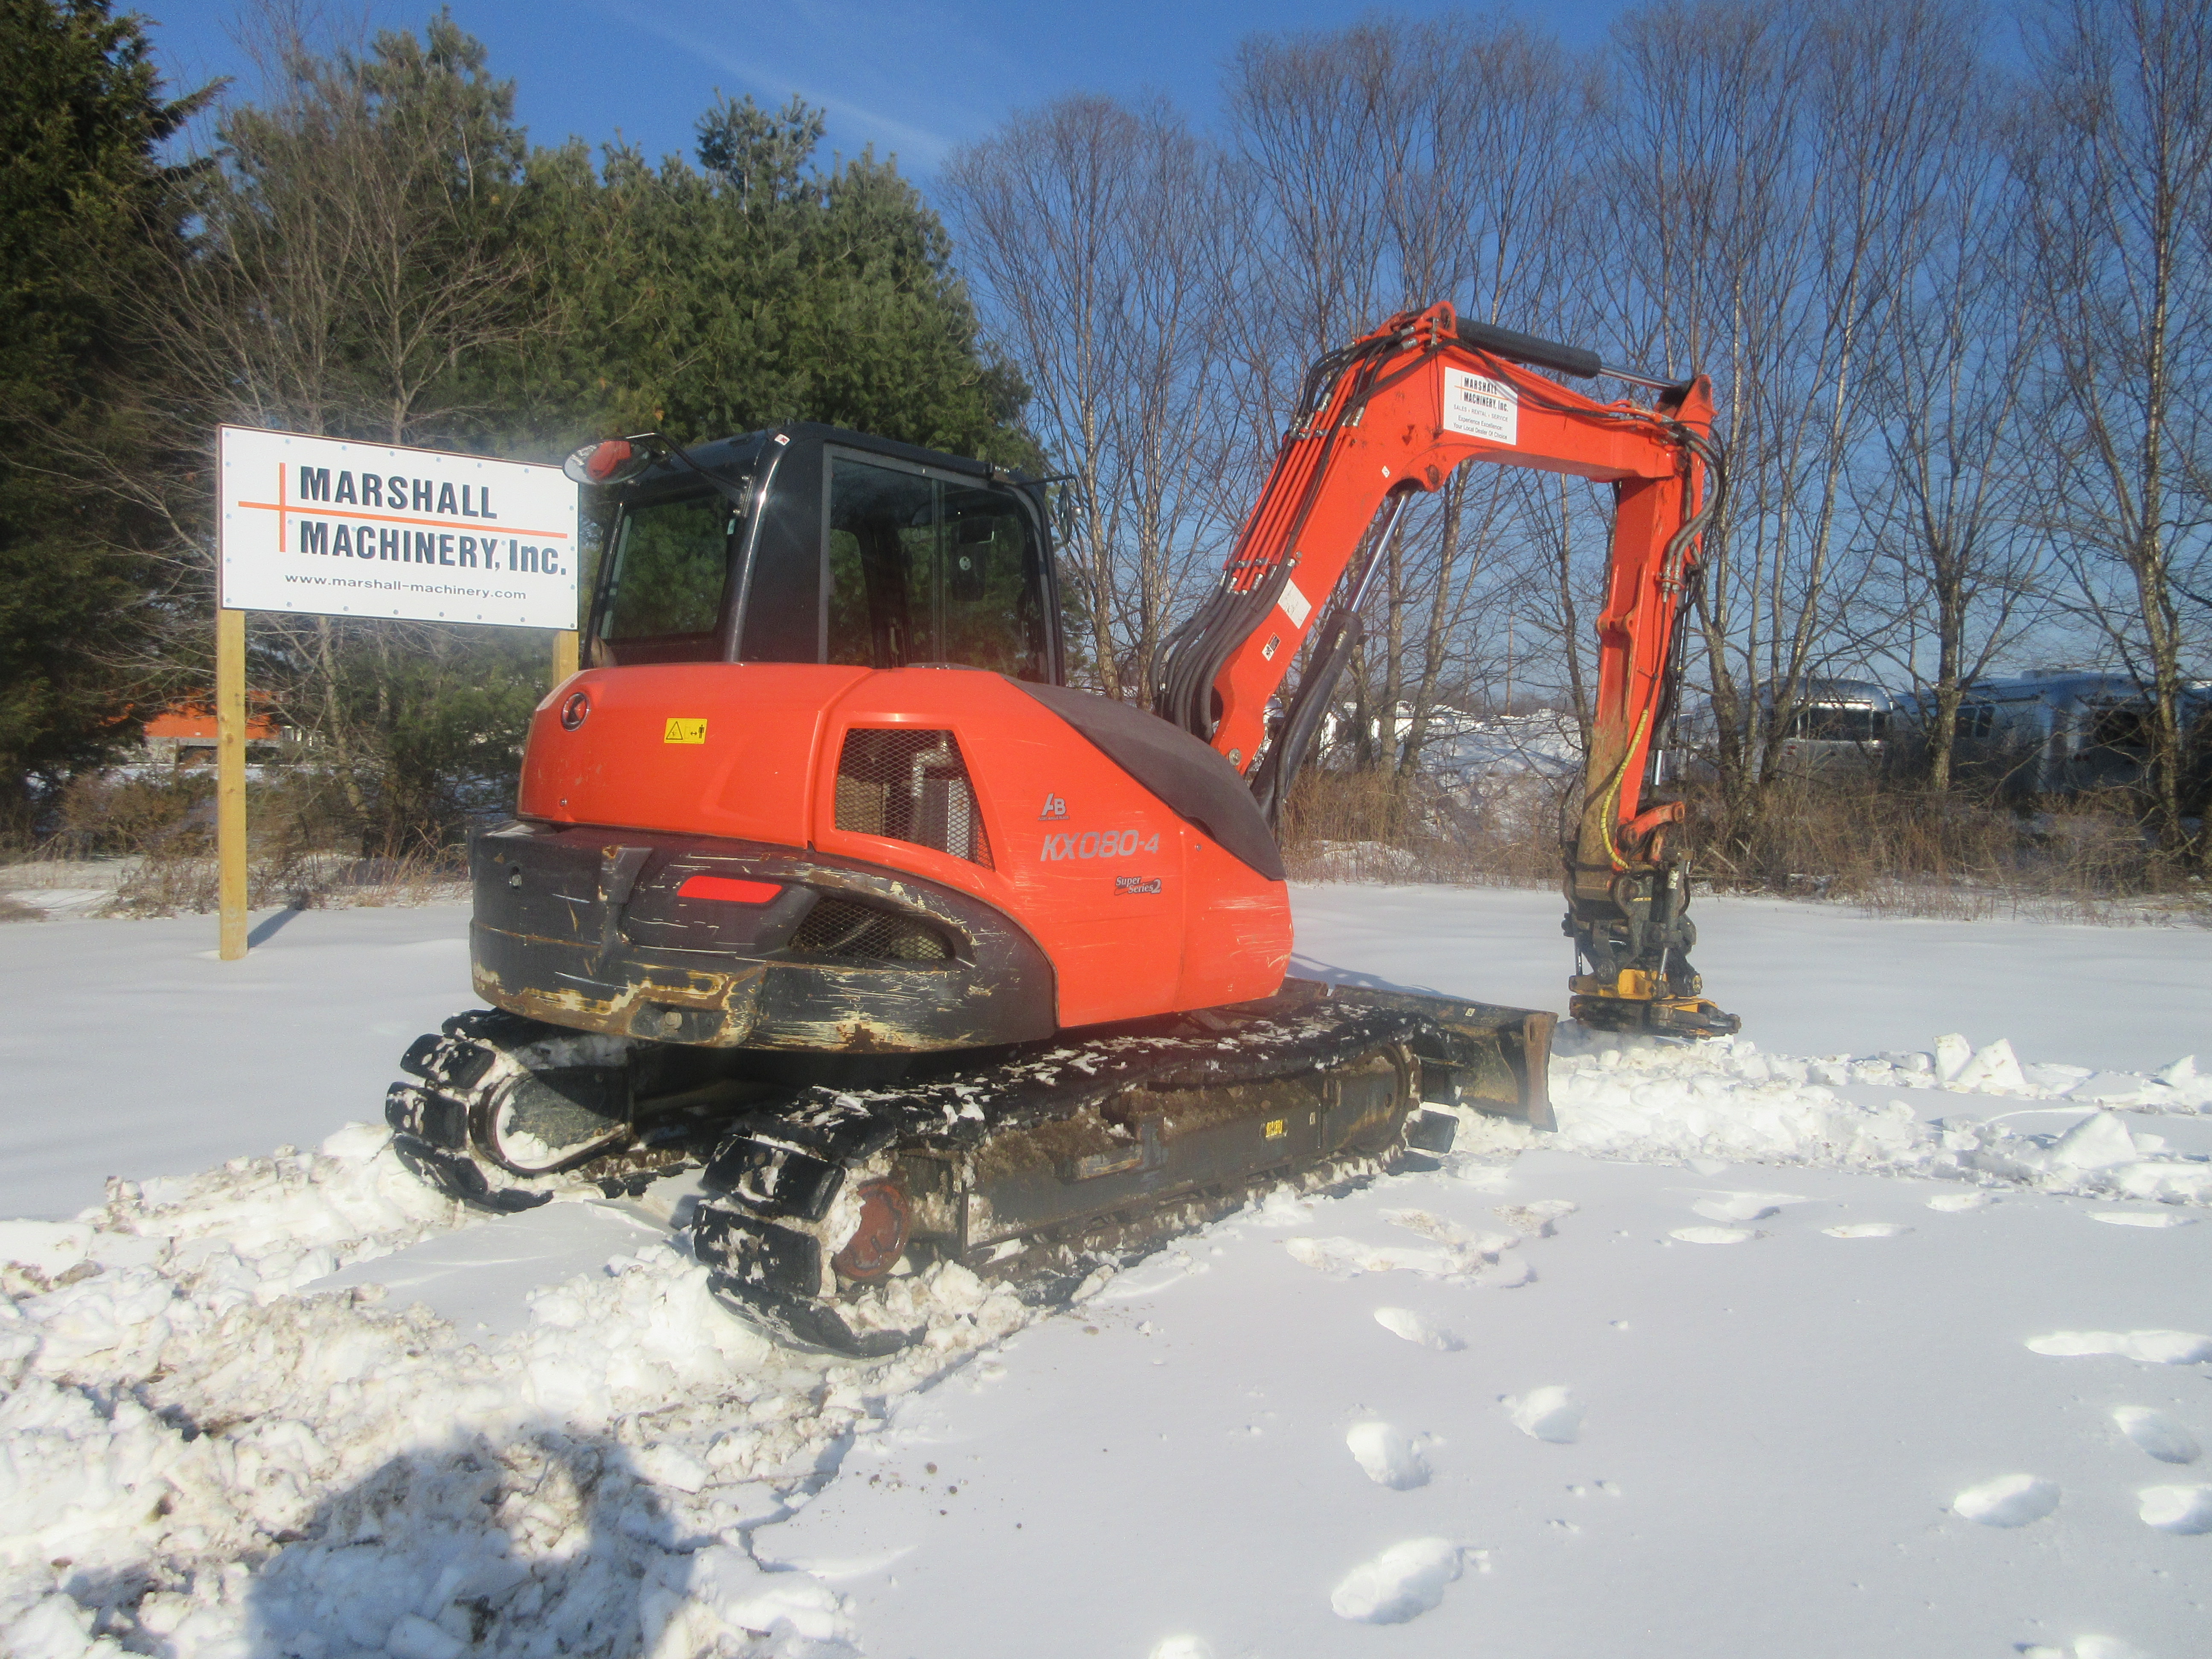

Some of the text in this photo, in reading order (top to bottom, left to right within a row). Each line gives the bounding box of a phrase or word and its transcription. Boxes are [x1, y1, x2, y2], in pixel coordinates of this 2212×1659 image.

[1464, 377, 1497, 395] MARSHALL
[1464, 392, 1508, 412] MACHINERY, Inc.
[1454, 404, 1508, 422] SALES RENTAL SERVICE
[1458, 415, 1480, 425] Experience
[1464, 425, 1474, 433] Local
[300, 466, 498, 519] MARSHALL
[300, 520, 567, 575] MACHINERY, Inc.
[285, 574, 526, 599] www.marshall-machinery.com
[1040, 830, 1160, 861] KX080-4
[1116, 876, 1141, 887] Super
